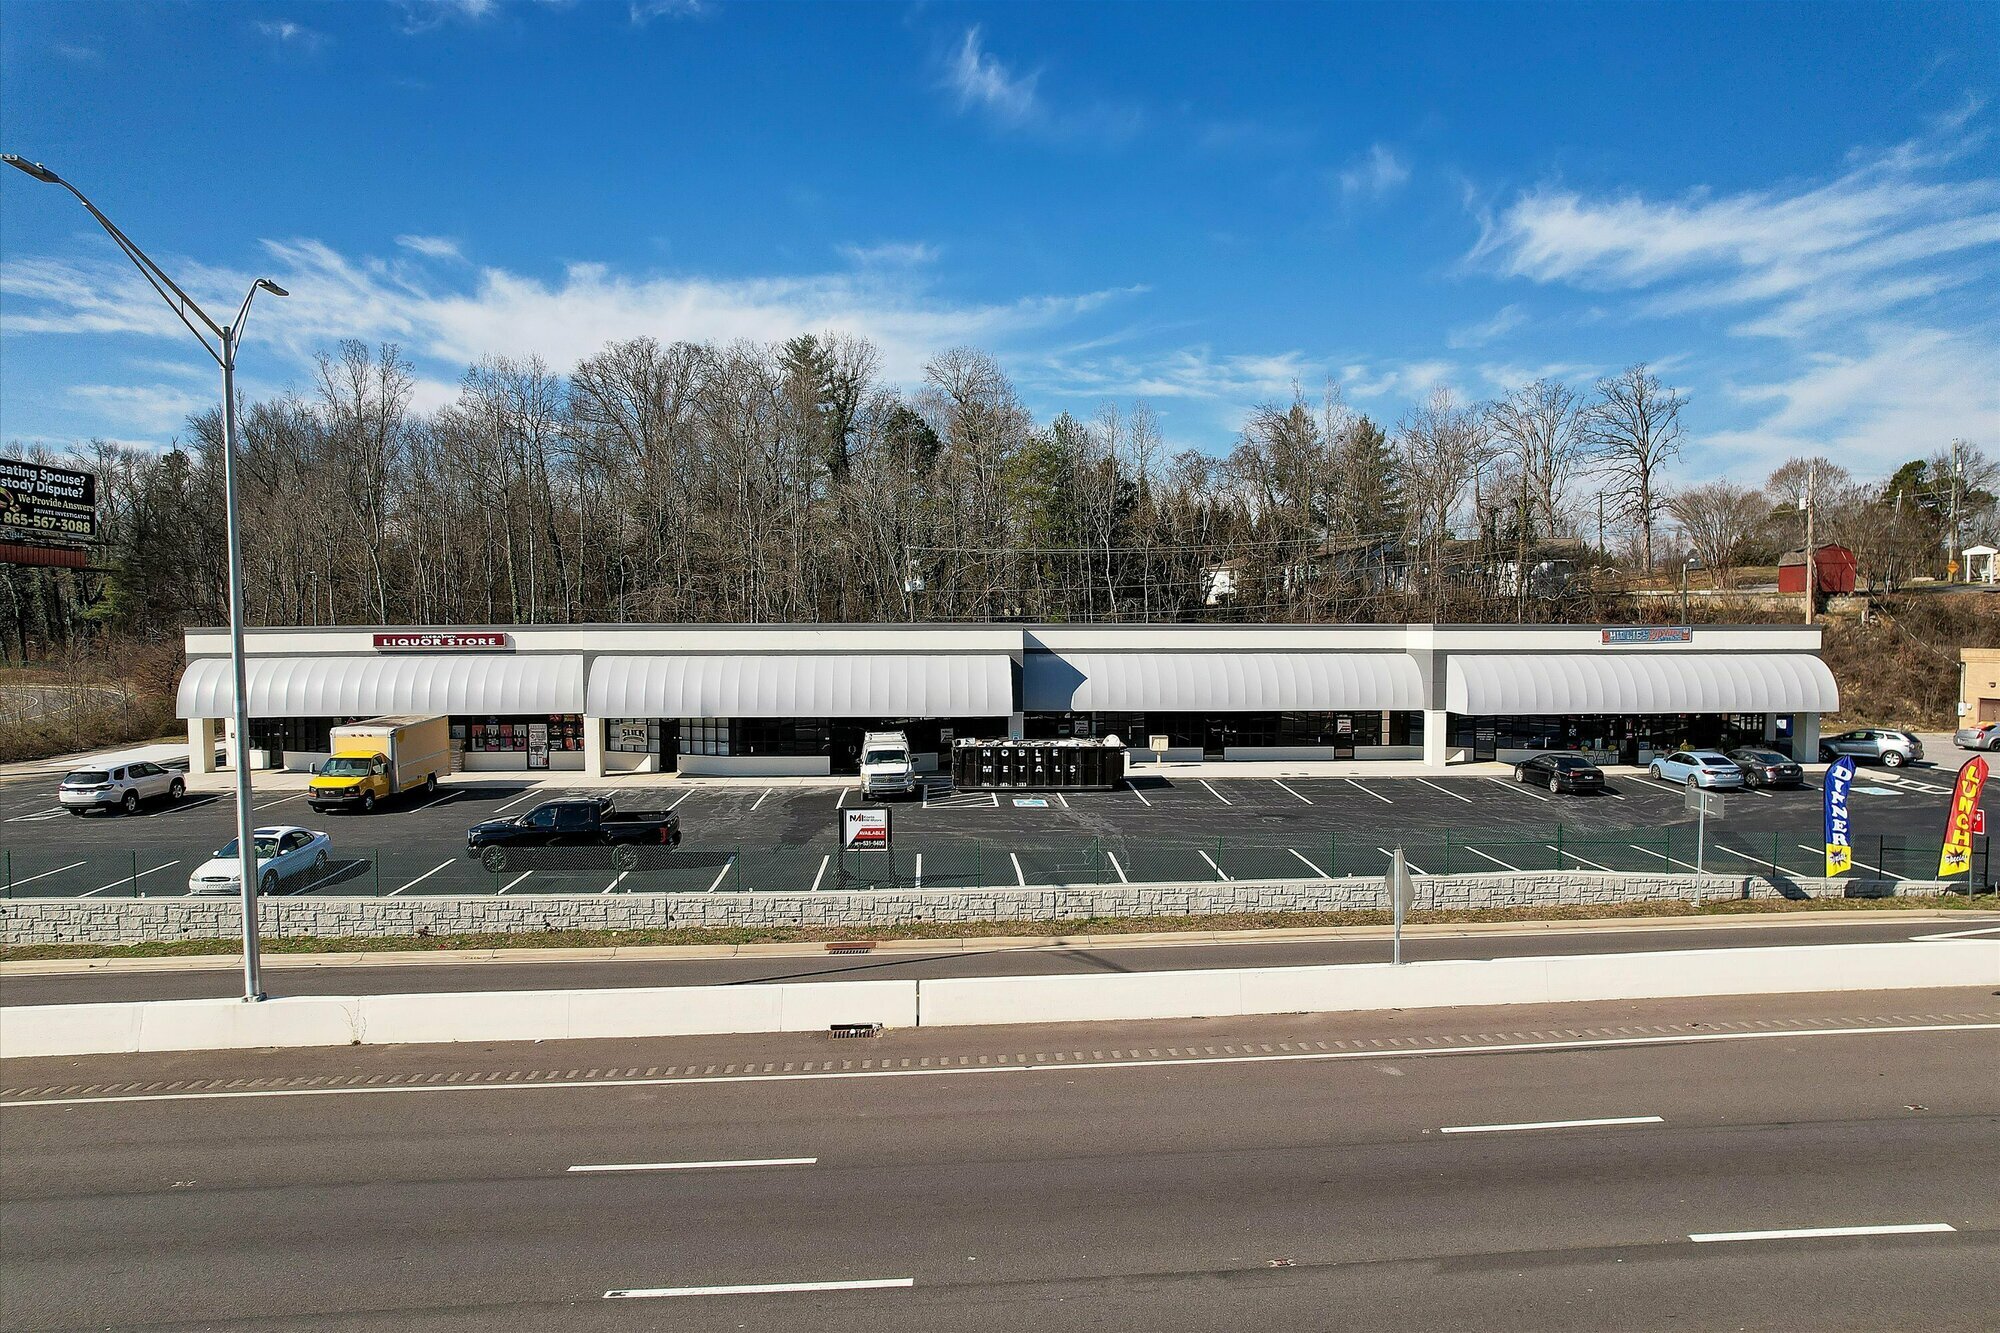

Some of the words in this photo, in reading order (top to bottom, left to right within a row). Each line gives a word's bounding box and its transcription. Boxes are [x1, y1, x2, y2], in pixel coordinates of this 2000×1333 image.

[40, 469, 86, 486] Spouse?
[37, 481, 84, 498] Dispute?
[18, 493, 31, 503] We
[32, 495, 62, 508] Provide
[63, 501, 95, 512] Answers
[4, 512, 90, 533] 865-567-3088
[34, 508, 54, 516] PRIVATE
[55, 511, 90, 520] INVESTIGATOR
[383, 638, 442, 646] LIQUOR
[447, 637, 496, 645] STORE
[982, 749, 1059, 757] NOBLE
[982, 765, 1076, 773] METALS
[1832, 765, 1852, 846] DINNER
[1952, 765, 1980, 847] LUNCH
